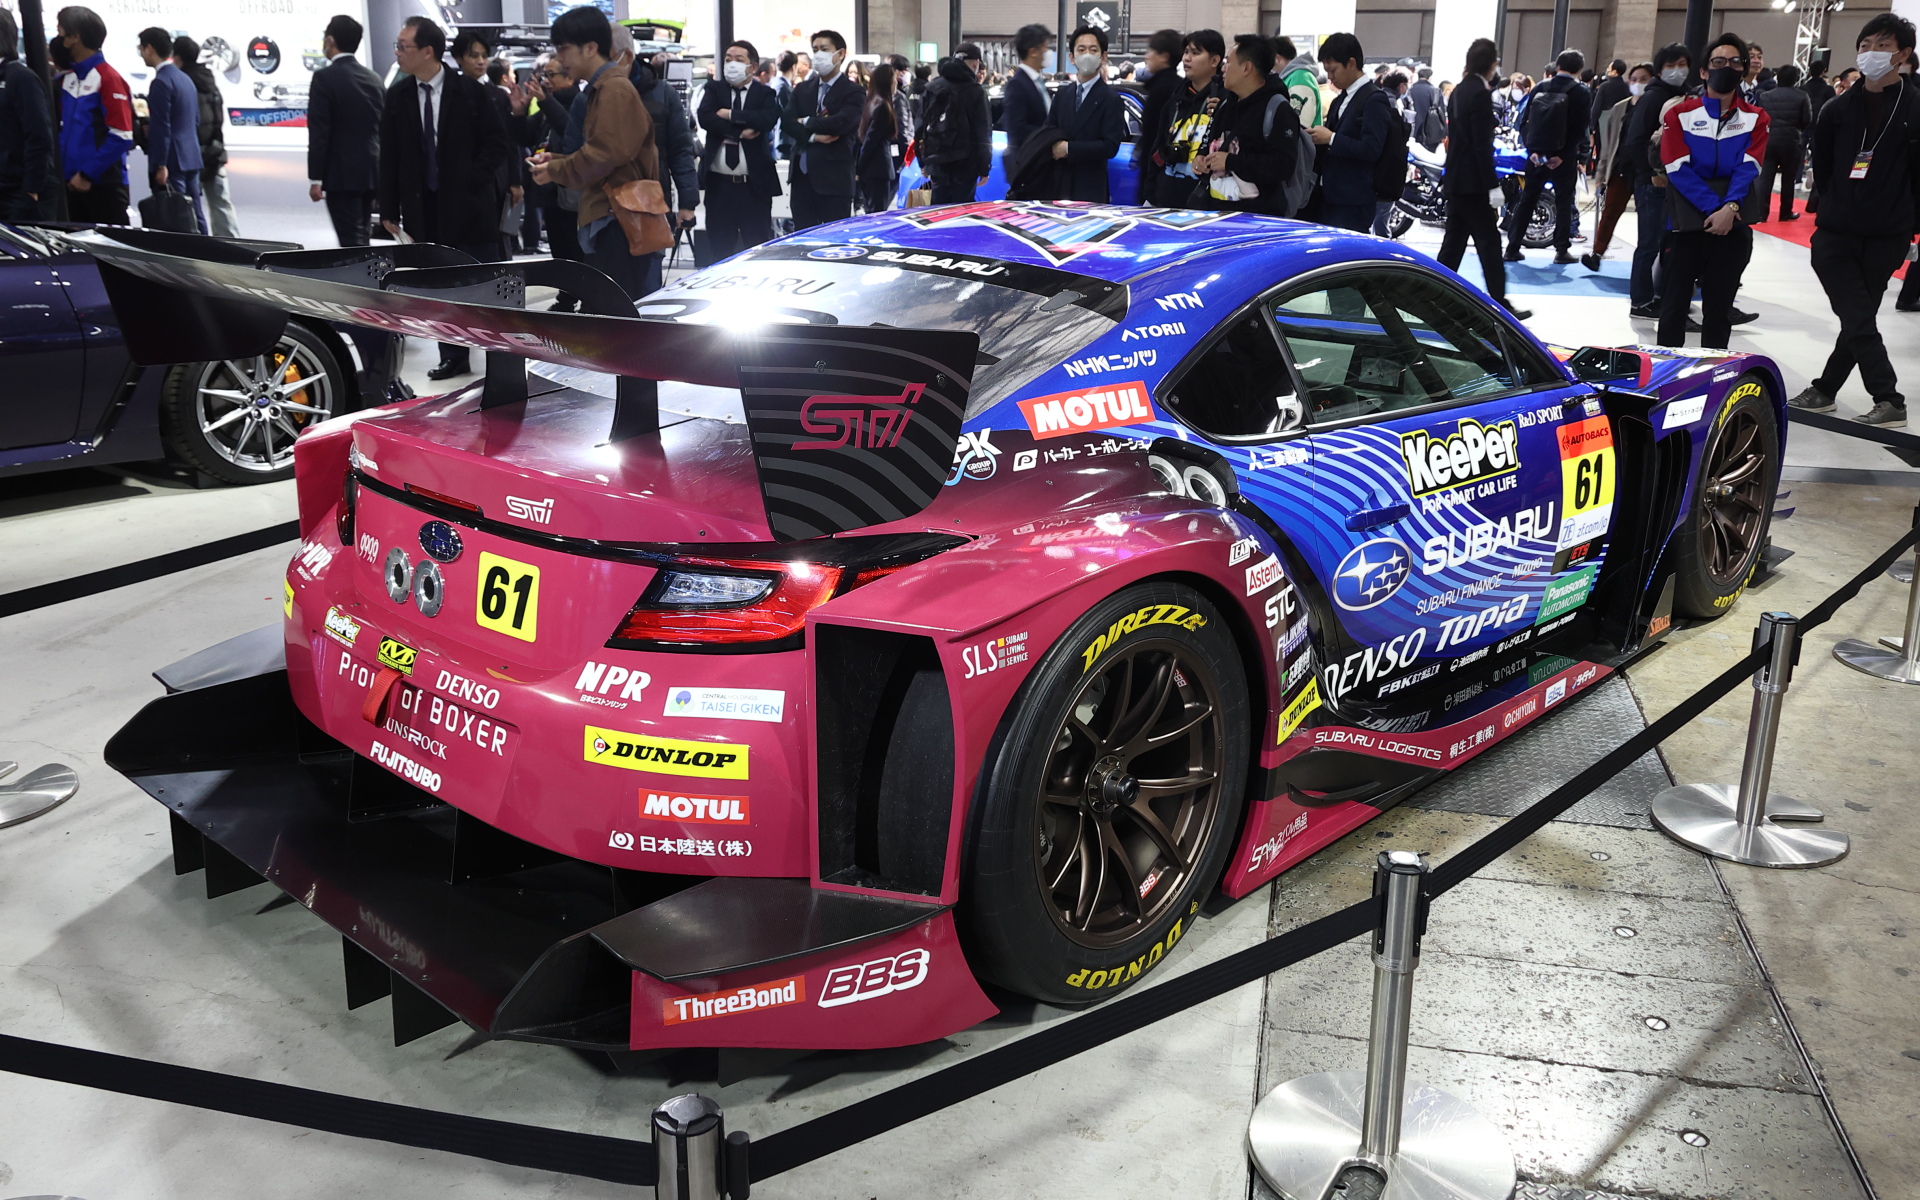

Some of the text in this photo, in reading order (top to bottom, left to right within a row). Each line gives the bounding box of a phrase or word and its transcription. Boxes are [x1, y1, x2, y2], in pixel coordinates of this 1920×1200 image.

[867, 249, 1006, 276] SUBARU
[1154, 291, 1204, 312] NTN
[1033, 387, 1148, 433] MOTUL
[1518, 413, 1535, 428] R&D
[1536, 405, 1563, 424] SPORT
[1679, 405, 1703, 416] Strada
[1571, 427, 1609, 445] AUTOBACS
[967, 460, 991, 471] GROUP
[1043, 447, 1082, 464] パーカー
[1404, 422, 1517, 492] KeePer
[1422, 475, 1517, 515] FOR SMART CAR LIFE
[1574, 453, 1603, 510] 61
[1423, 501, 1554, 575] SUBARU
[1562, 517, 1608, 543] ZF zf.com/jp
[1511, 557, 1543, 578] MIZUHO
[482, 565, 533, 630] 61
[1415, 572, 1504, 616] SUBARU FINANCE
[1541, 589, 1587, 618] AUTOMOTIVE
[1547, 574, 1589, 603] Panasonic
[1265, 583, 1296, 628] STC
[325, 608, 359, 640] KeePer
[1006, 631, 1028, 645] SUBARU
[1082, 604, 1207, 675] DIREZZA
[962, 640, 998, 679] SLS
[1006, 643, 1025, 656] LIVING
[1007, 652, 1028, 666] SERVICE
[575, 661, 651, 702] NPR
[1325, 627, 1427, 710] DENSO
[338, 651, 508, 757] Pro of BOXER
[435, 670, 500, 710] DENSO
[701, 701, 781, 715] TAISEI GIKEN
[1511, 699, 1537, 724] CHIYODA
[383, 716, 448, 761] UNSROCK
[613, 741, 736, 768] DUNLOP
[1315, 731, 1443, 761] SUBARU LOGISTICS
[370, 740, 442, 792] FUJITSUBO
[644, 793, 745, 821] MOTUL
[1066, 918, 1183, 990] DUNLOP
[817, 948, 930, 1008] BBS
[674, 980, 796, 1021] ThreeBond
